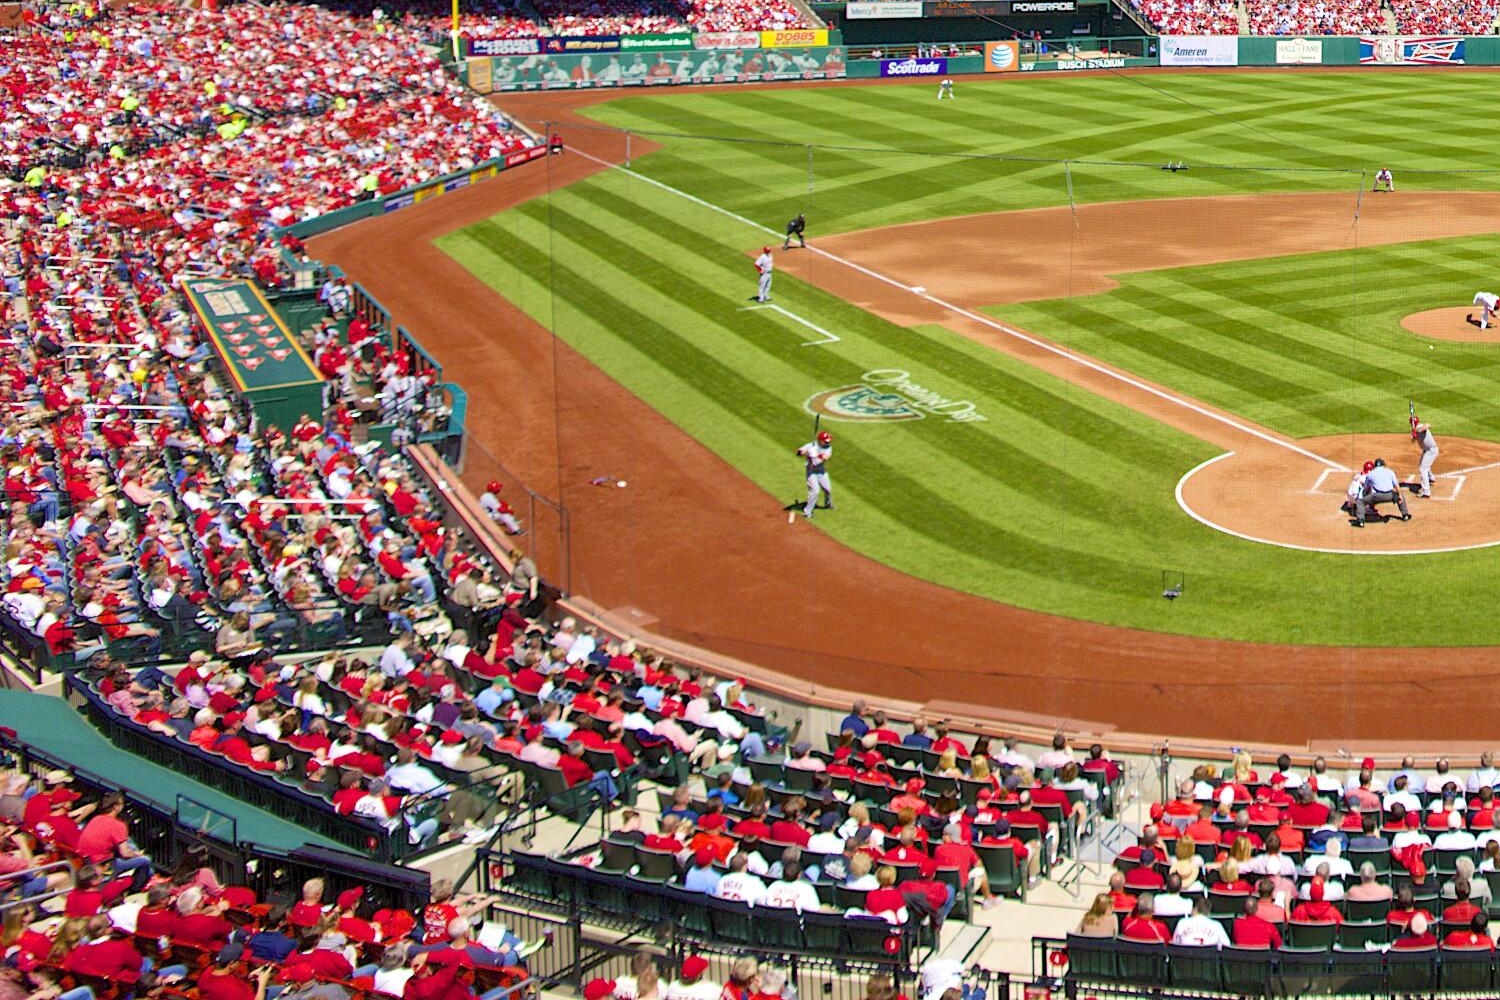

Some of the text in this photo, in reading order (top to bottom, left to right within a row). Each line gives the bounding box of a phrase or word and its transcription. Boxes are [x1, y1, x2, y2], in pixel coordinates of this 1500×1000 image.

[851, 7, 872, 17] Mercy
[1012, 1, 1075, 13] POWERADE
[674, 37, 691, 46] Bank
[775, 32, 815, 42] DOBBS
[1174, 46, 1208, 58] Ameren
[1278, 45, 1320, 53] HALL FAME
[887, 59, 941, 75] Scottrade
[1058, 60, 1086, 70] BUSCH
[1089, 58, 1125, 69] STADIUM
